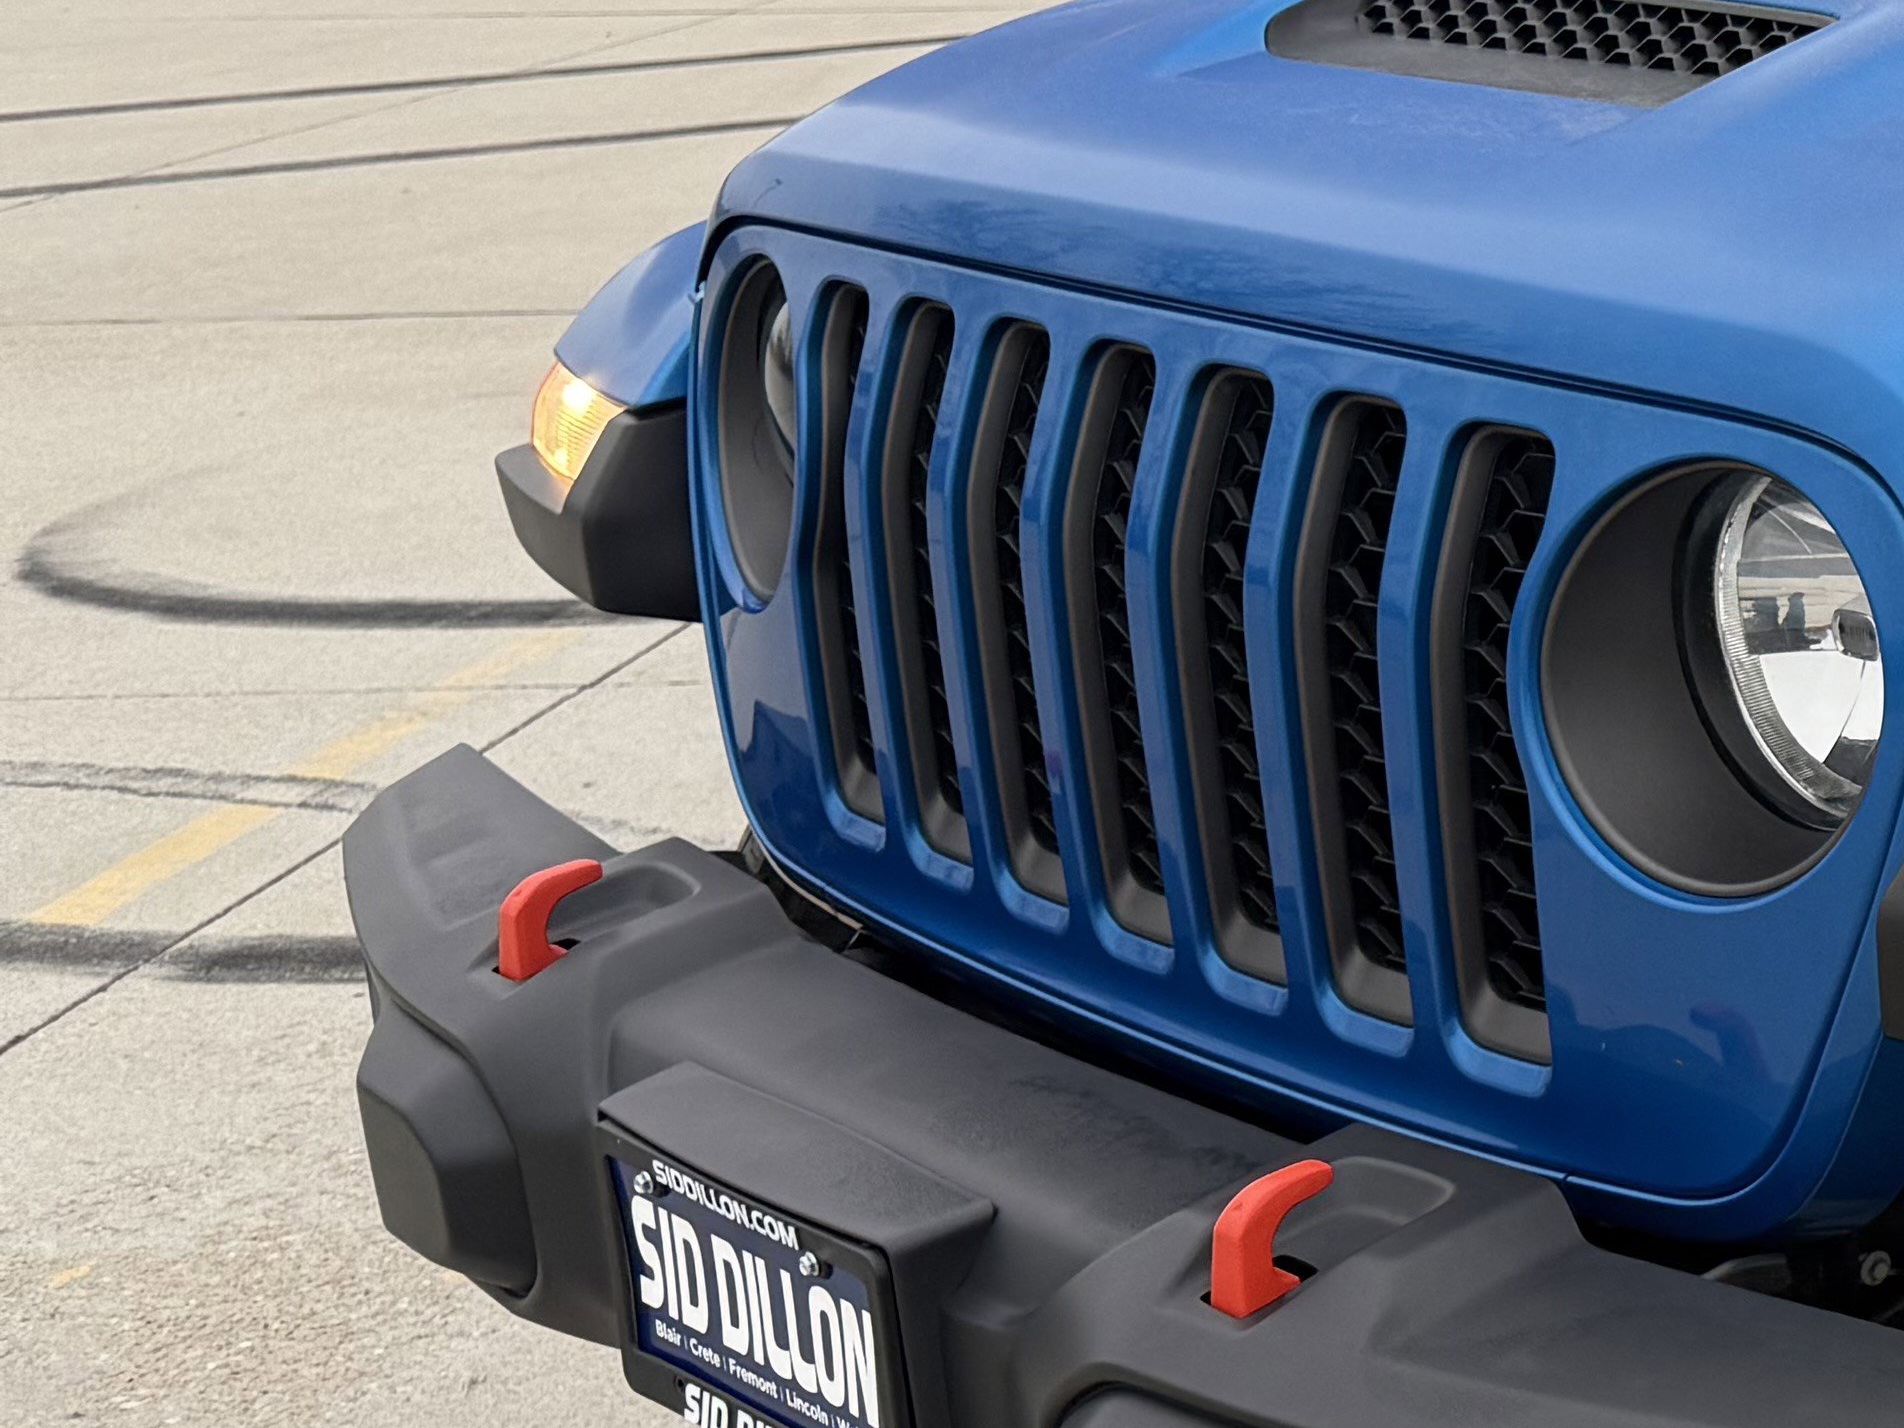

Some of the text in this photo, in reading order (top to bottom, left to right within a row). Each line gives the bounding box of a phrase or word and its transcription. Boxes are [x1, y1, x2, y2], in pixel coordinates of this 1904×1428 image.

[651, 1158, 799, 1251] SIDDILLON.COM
[630, 1194, 709, 1335] SID
[654, 1318, 682, 1348] Blair
[688, 1339, 722, 1369] Crete
[728, 1359, 779, 1400] Fremont
[785, 1390, 830, 1427] Lincoln
